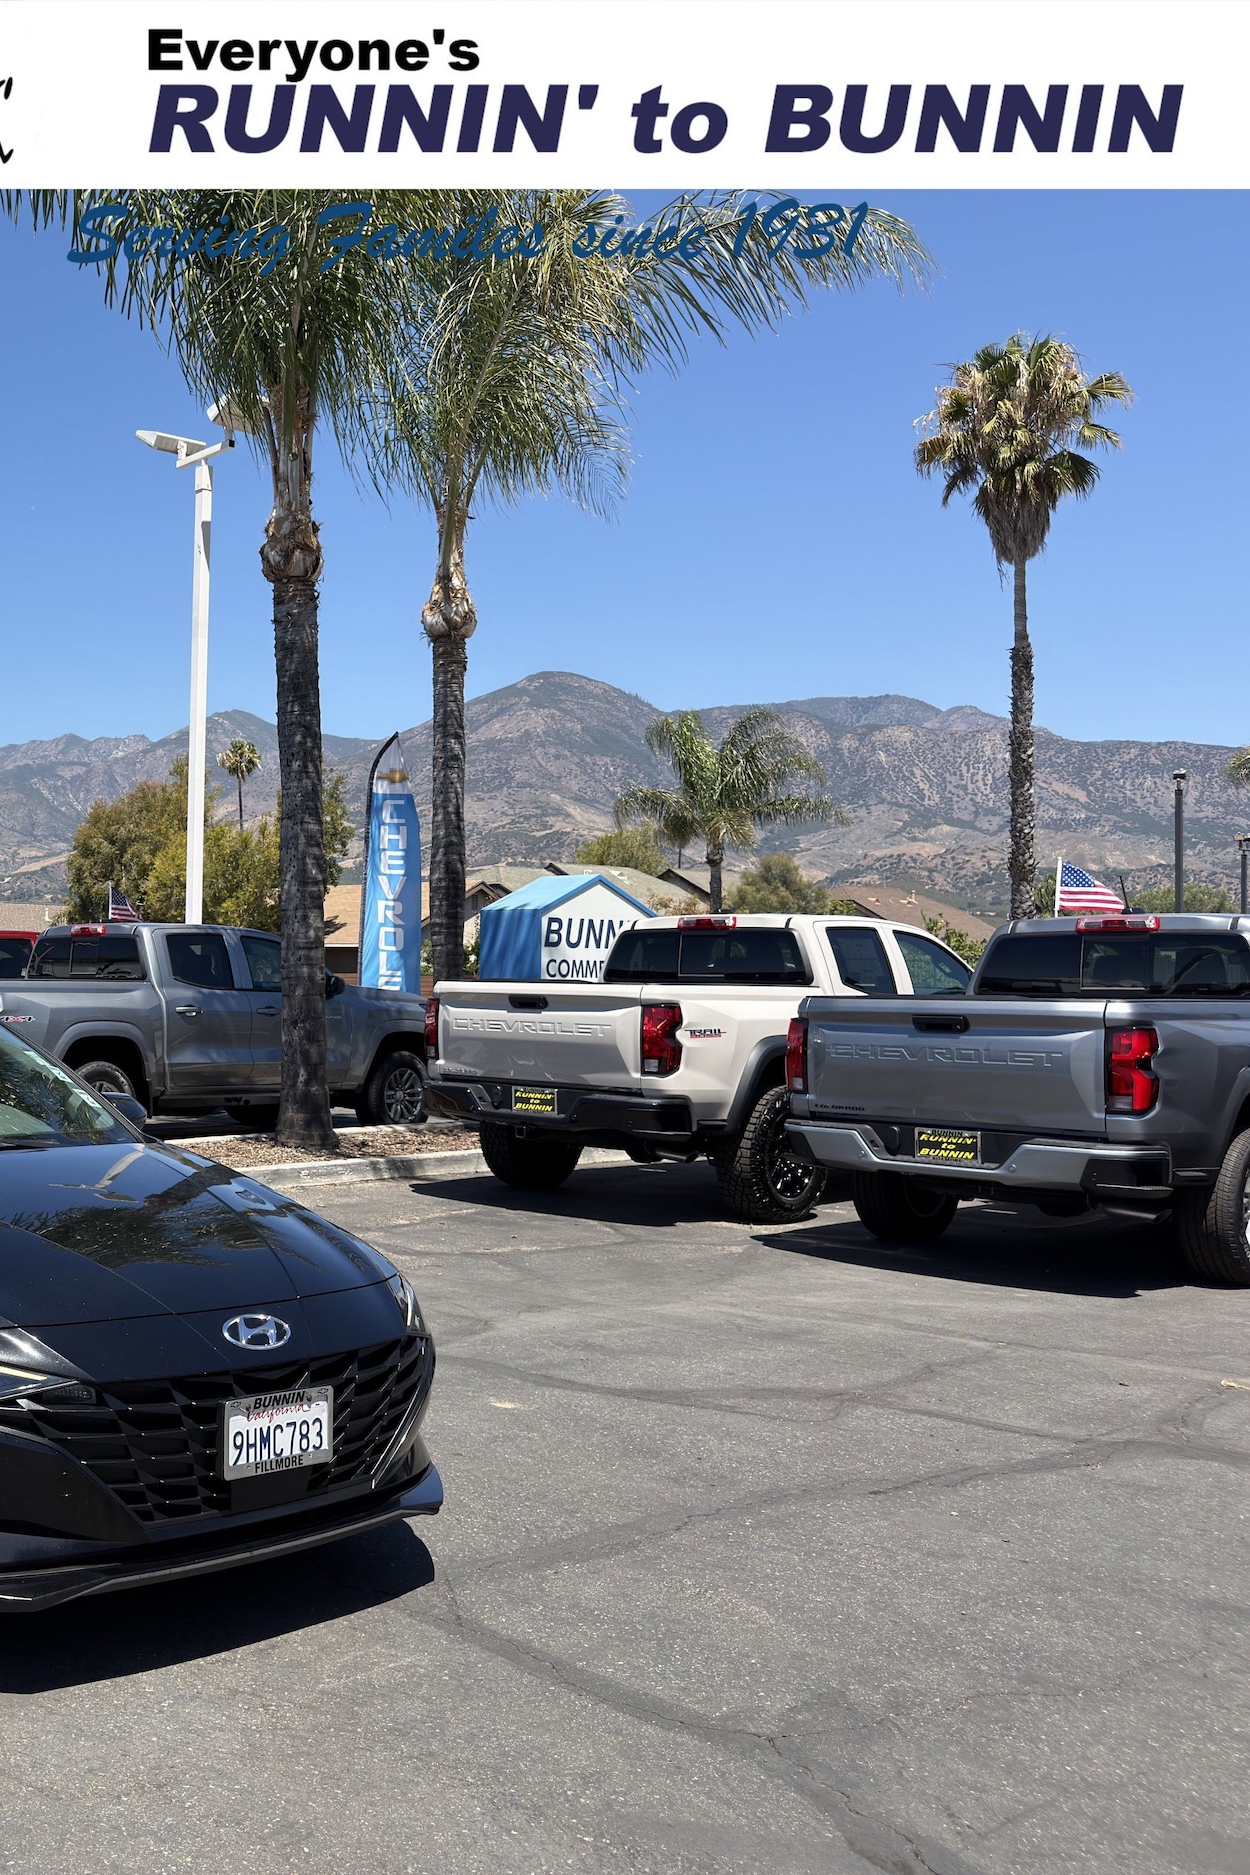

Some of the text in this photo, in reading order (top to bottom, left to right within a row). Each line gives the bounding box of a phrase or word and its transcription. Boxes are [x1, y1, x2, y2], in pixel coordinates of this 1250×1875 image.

[543, 916, 625, 950] BUNN
[452, 1017, 612, 1037] CHEVROLET
[829, 1043, 1063, 1067] CHEVROLET
[515, 1102, 553, 1112] BUNNIN
[919, 1147, 975, 1160] BUNNIN
[941, 1142, 956, 1150] to
[253, 1390, 306, 1410] BUNNIN
[232, 1417, 324, 1466] 9HMC783
[254, 1454, 304, 1474] FILLMORE
